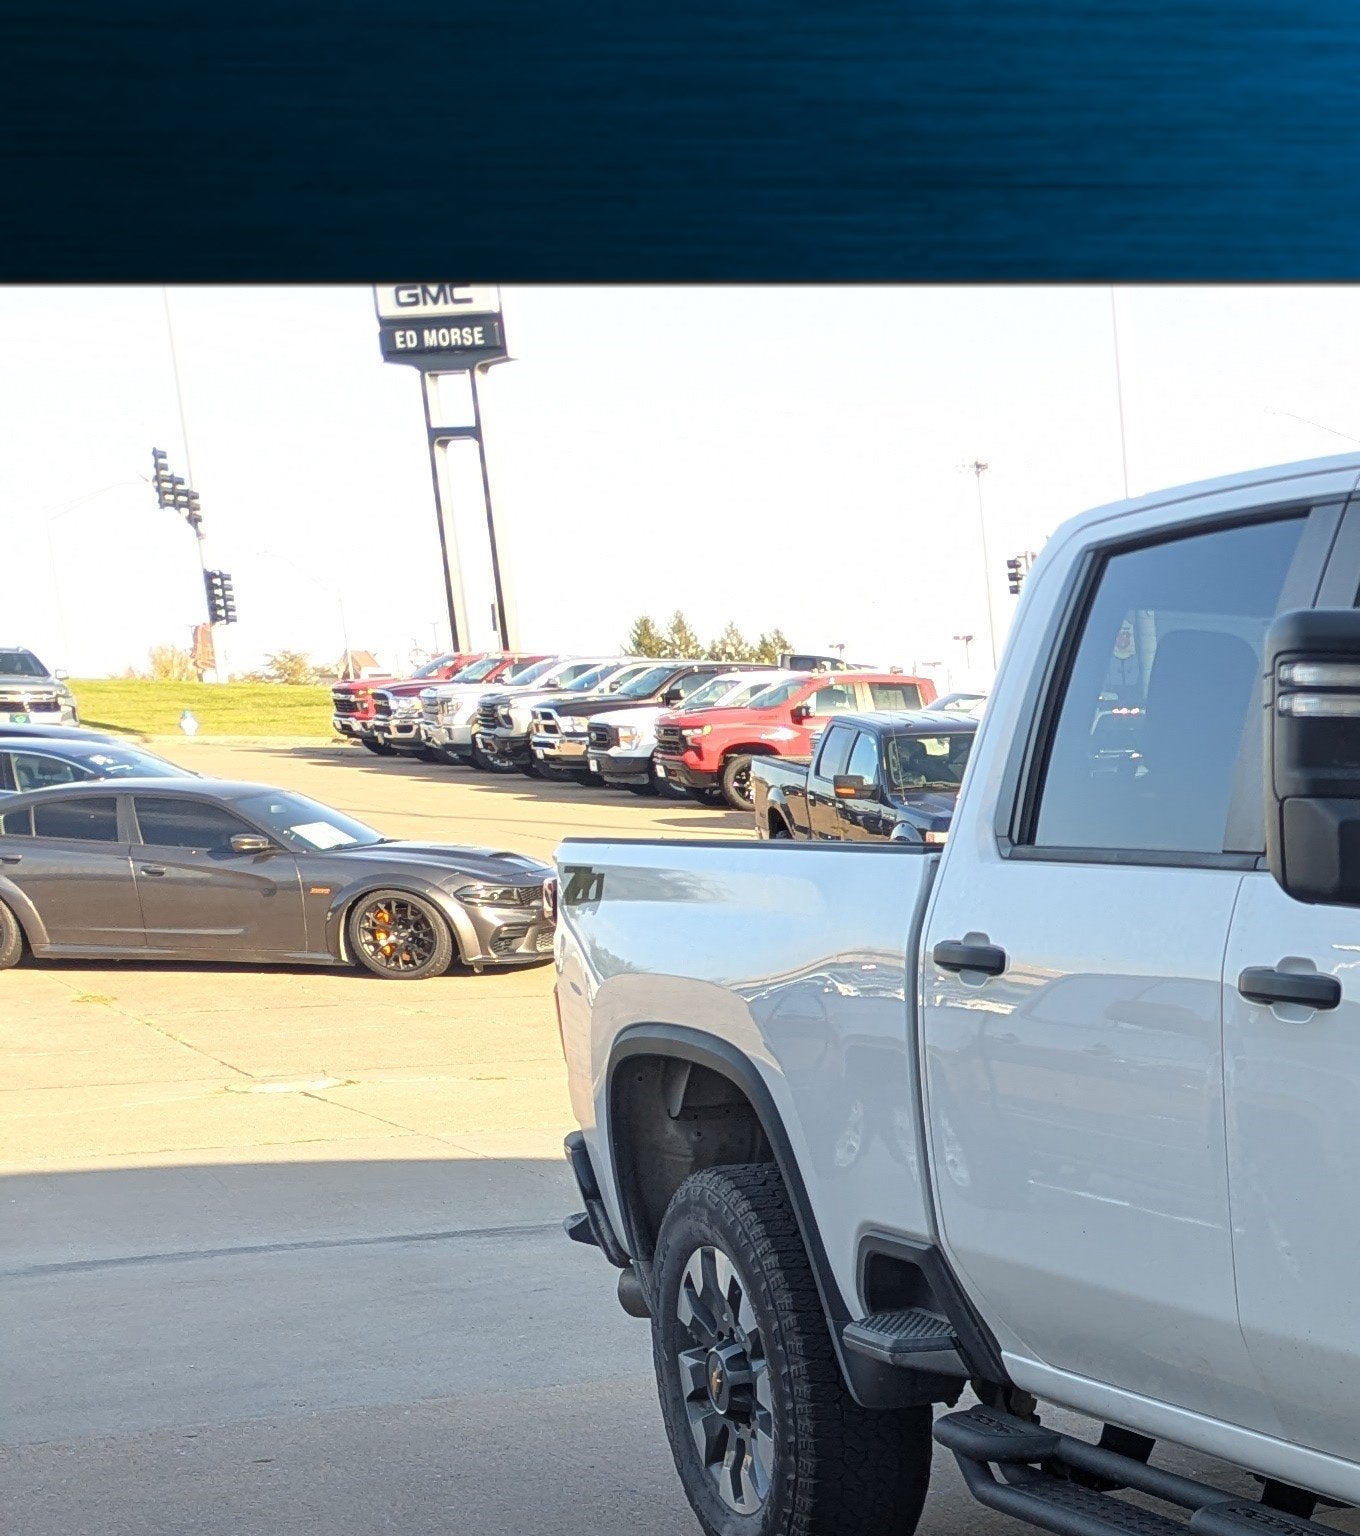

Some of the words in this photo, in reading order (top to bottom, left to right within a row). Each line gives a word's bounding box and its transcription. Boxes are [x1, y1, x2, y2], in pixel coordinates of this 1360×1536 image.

[394, 284, 474, 308] GMC
[394, 330, 418, 349] ED
[423, 326, 485, 347] MORSE
